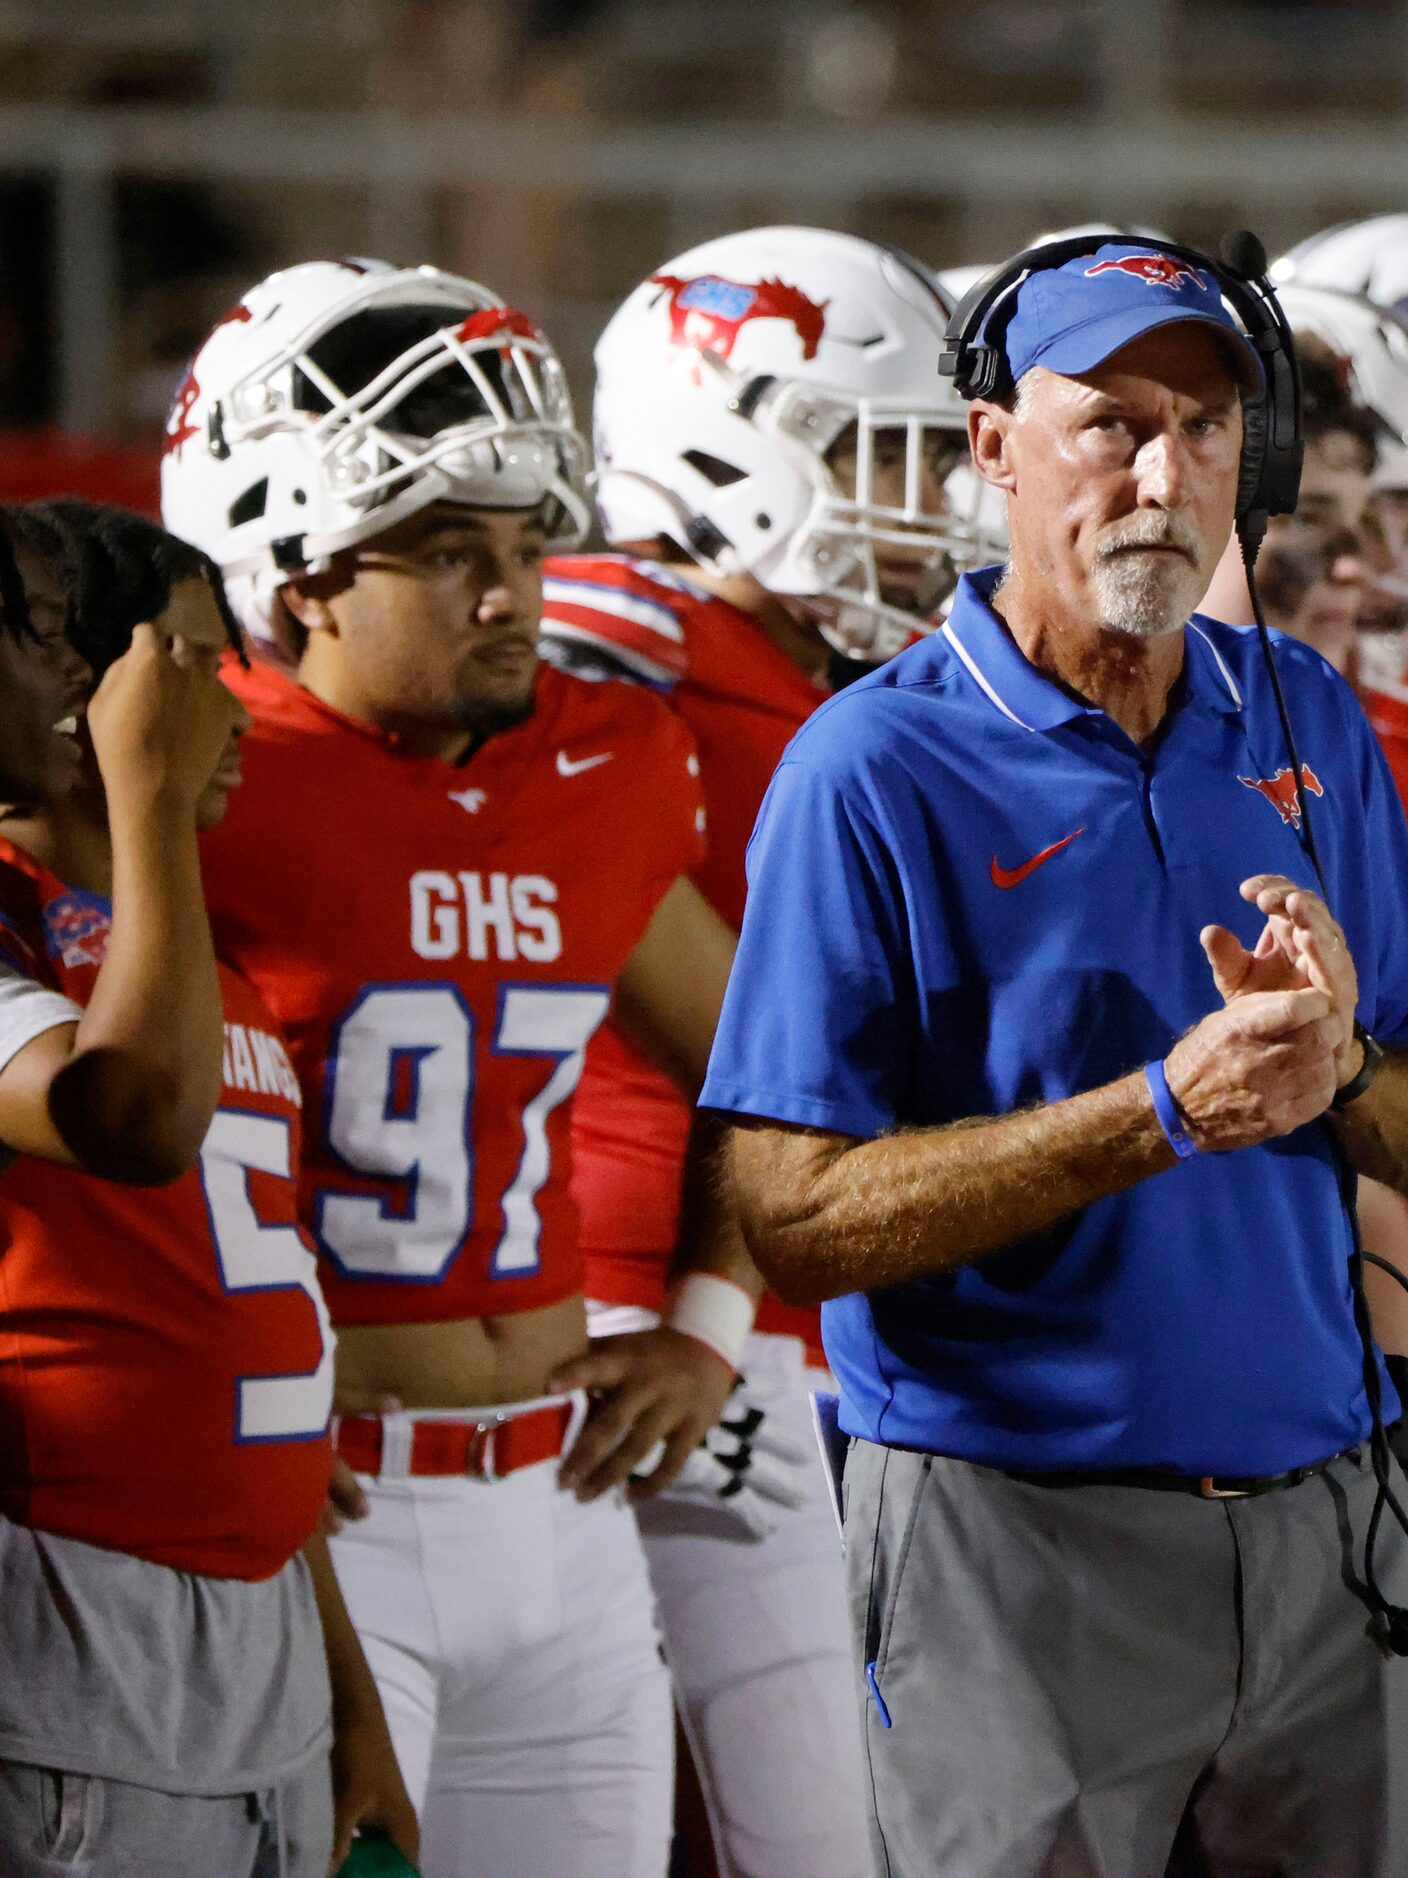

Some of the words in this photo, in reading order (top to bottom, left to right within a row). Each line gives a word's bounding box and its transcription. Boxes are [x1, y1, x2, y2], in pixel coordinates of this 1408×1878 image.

[409, 868, 562, 963] GHS
[199, 1106, 340, 1446] 5
[315, 979, 612, 1285] 97
